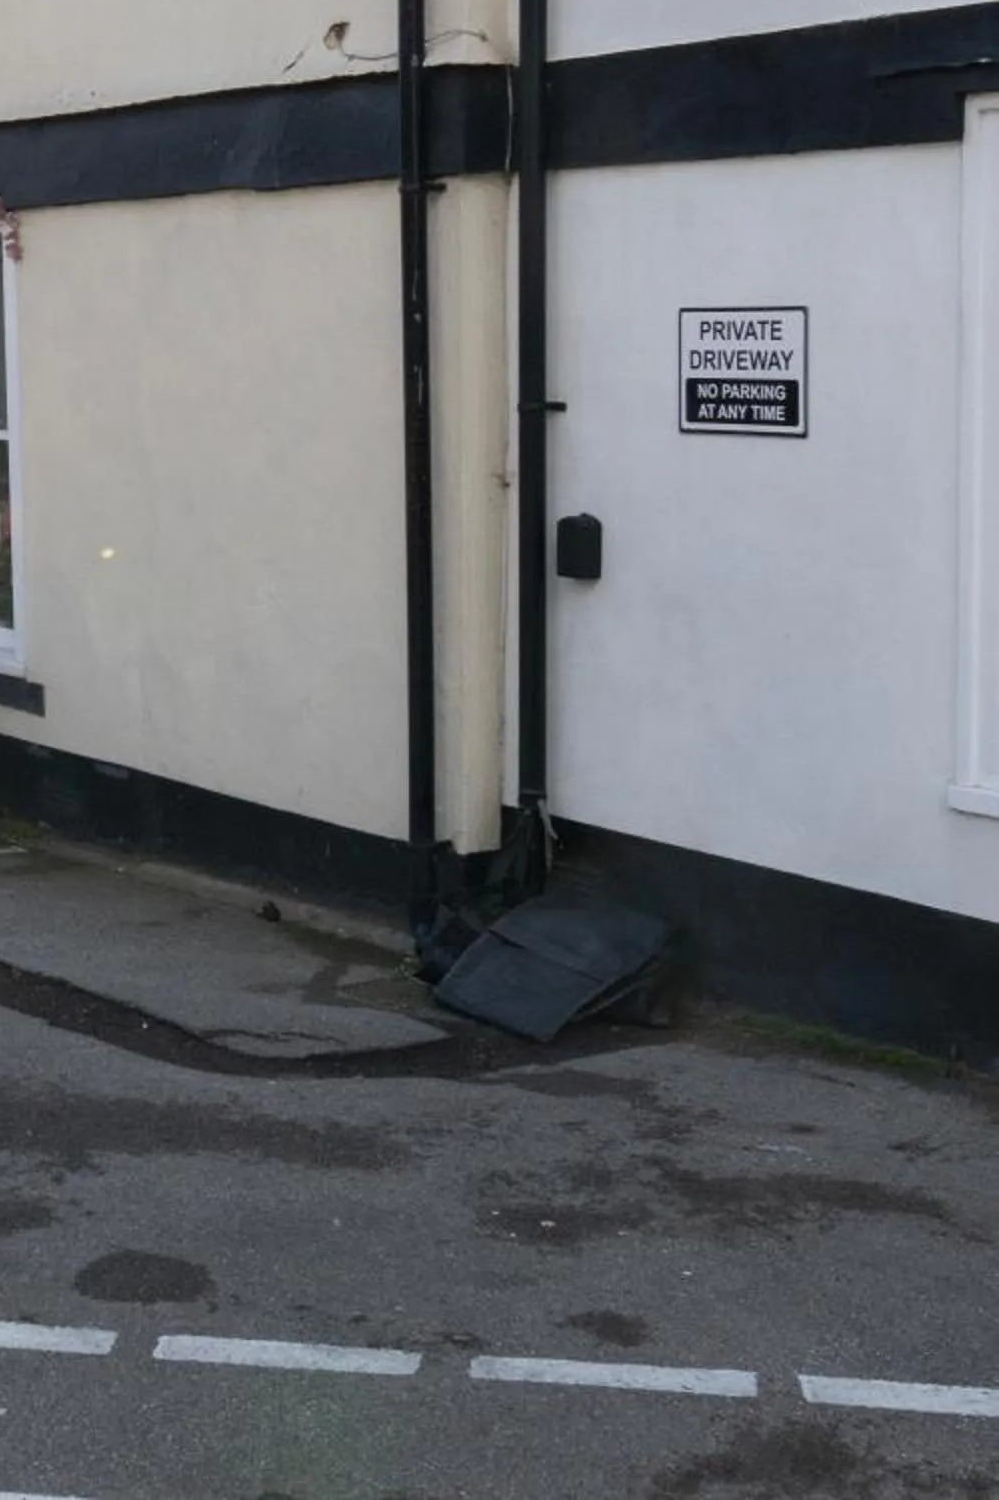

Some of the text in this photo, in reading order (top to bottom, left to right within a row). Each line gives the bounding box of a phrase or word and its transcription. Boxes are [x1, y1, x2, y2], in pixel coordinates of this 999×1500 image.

[700, 320, 783, 341] PRIVATE
[689, 349, 794, 371] DRIVEWAY
[697, 383, 786, 401] NO PARKING
[698, 403, 786, 421] AT ANY TIME
